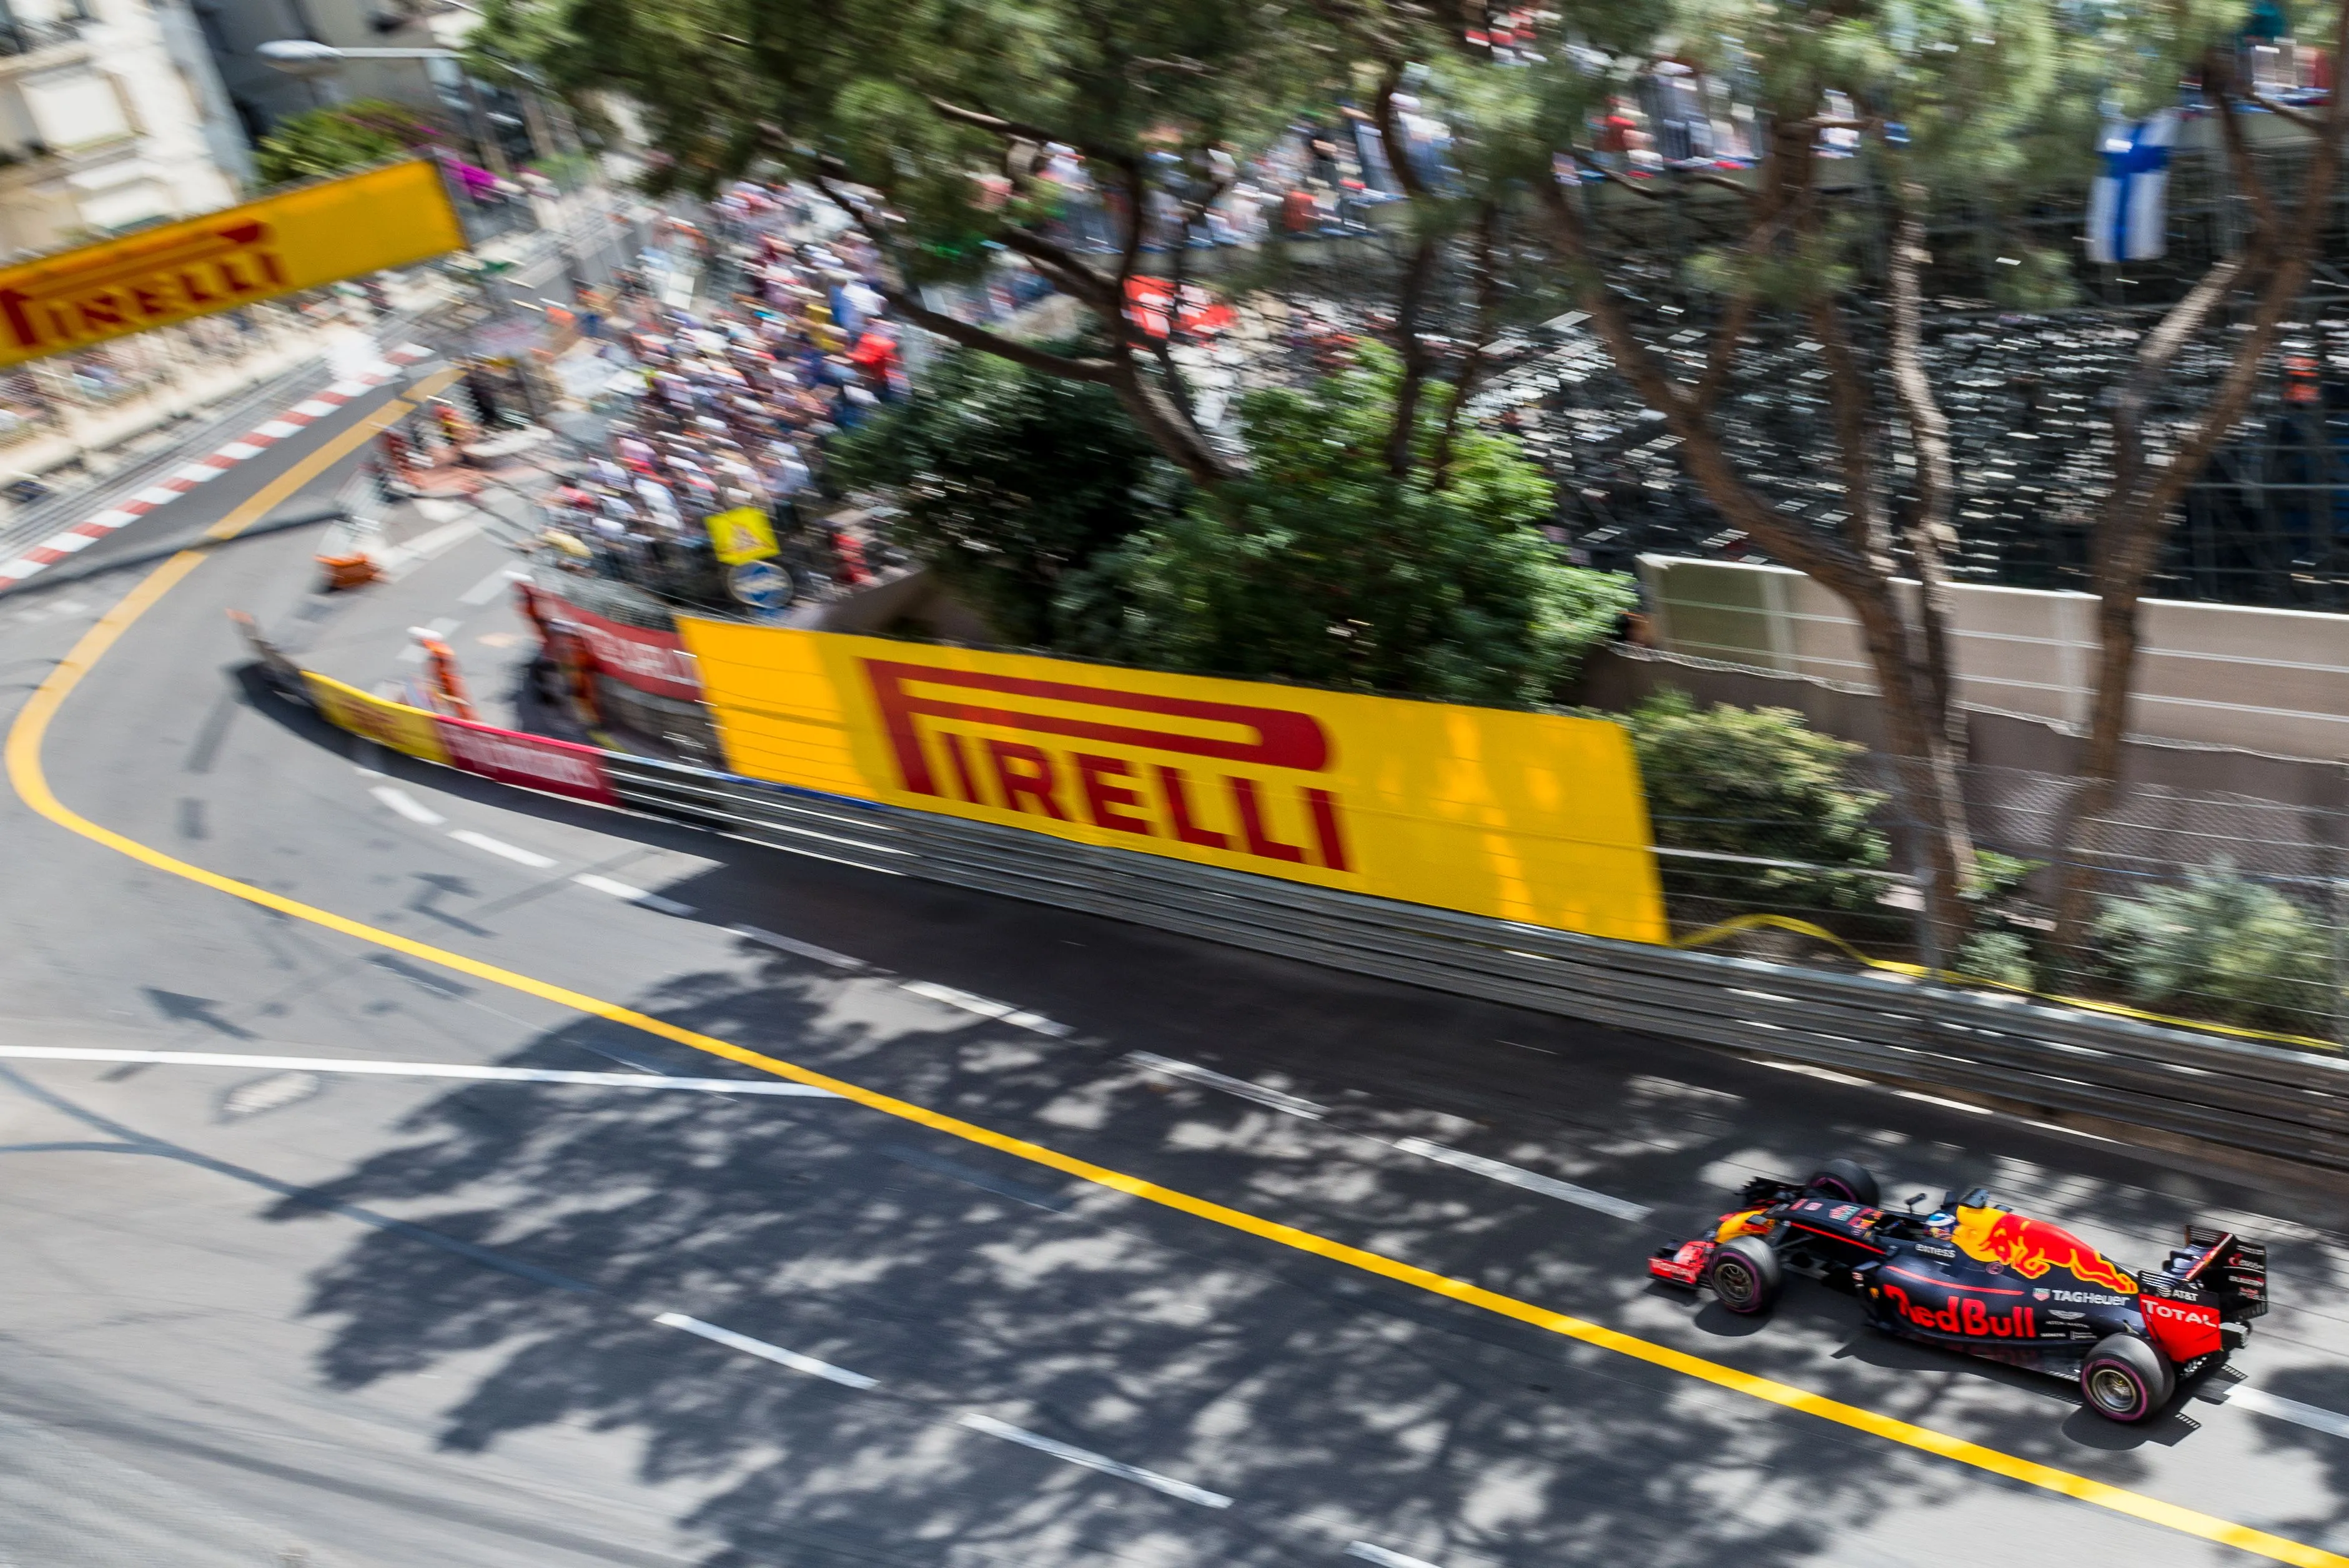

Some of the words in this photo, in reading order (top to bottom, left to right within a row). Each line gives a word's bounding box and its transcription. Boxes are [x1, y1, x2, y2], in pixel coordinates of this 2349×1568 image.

[0, 221, 290, 347] PIRELLI
[859, 658, 1353, 872] PIRELLI
[2141, 1299, 2218, 1328] TOTAL
